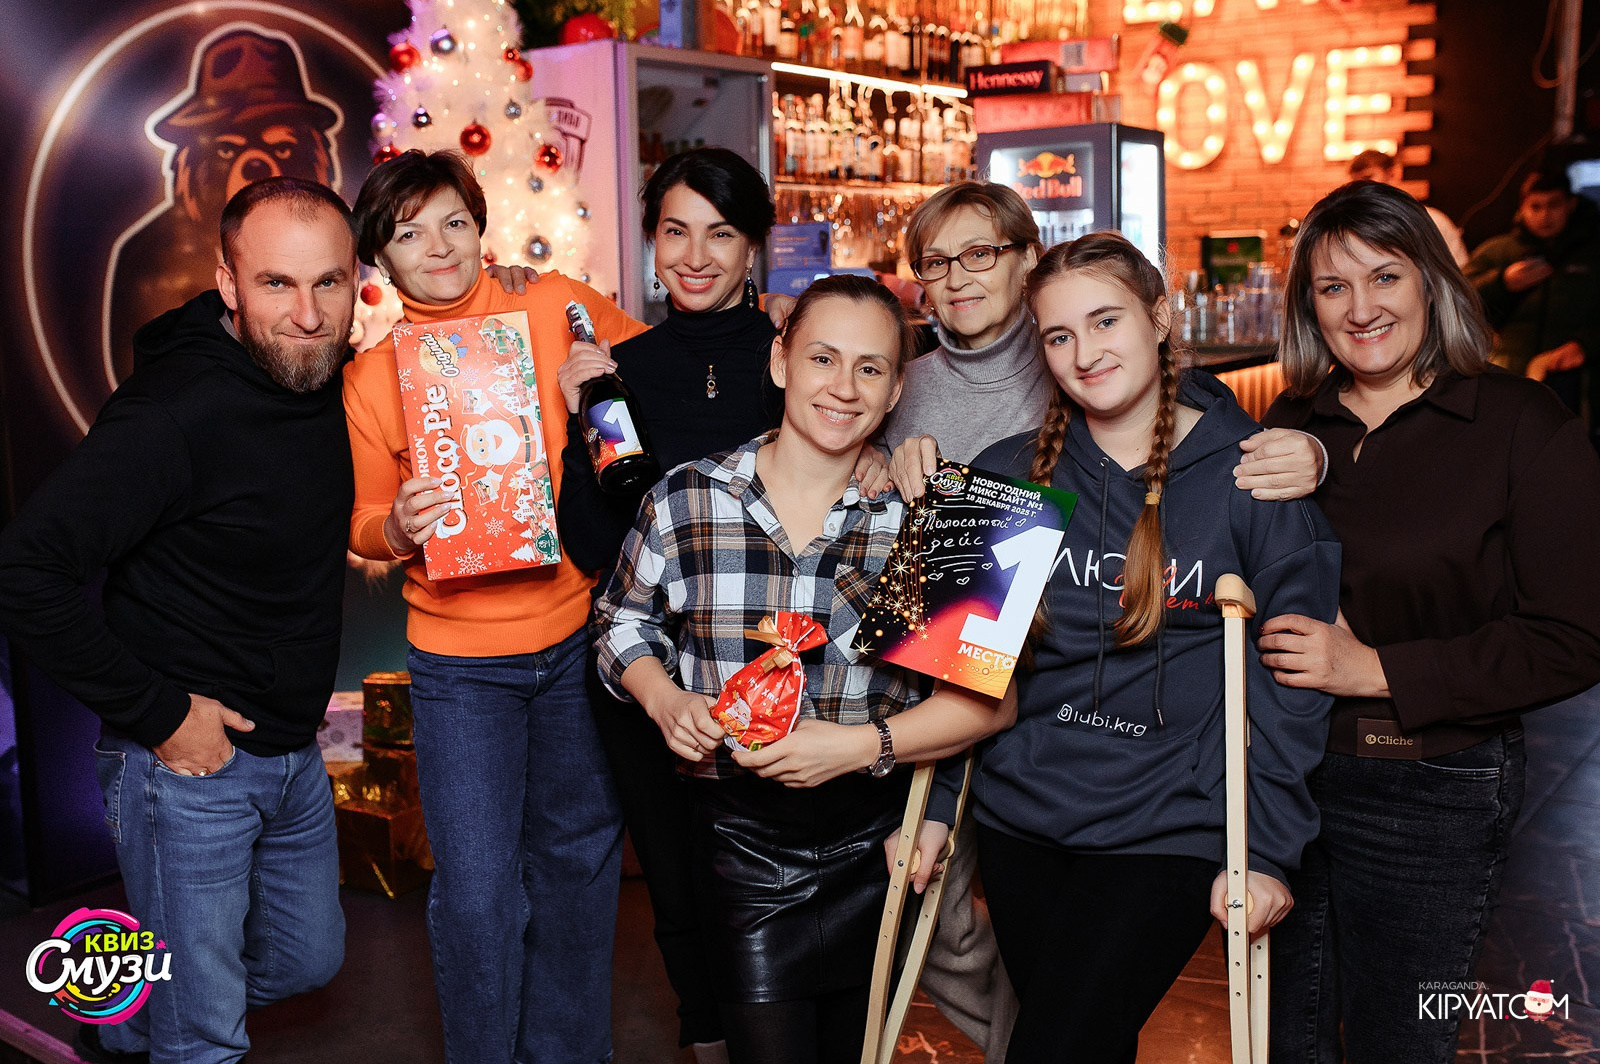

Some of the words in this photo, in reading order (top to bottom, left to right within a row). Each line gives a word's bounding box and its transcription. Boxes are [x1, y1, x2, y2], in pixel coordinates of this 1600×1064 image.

[969, 69, 1045, 91] Hennessy
[1047, 175, 1083, 199] Bull
[418, 332, 460, 377] Original
[603, 400, 643, 455] 1
[930, 472, 966, 490] Смузи
[972, 476, 1042, 501] НОВОГОДНИЙ
[965, 494, 976, 502] 18
[975, 497, 1011, 511] ДЕКАБРЯ
[1011, 506, 1030, 516] 2025
[968, 484, 998, 499] МИКС
[998, 493, 1027, 506] ЛАЙТ
[1027, 501, 1043, 511] №1
[923, 509, 1012, 531] Полосатый
[1047, 547, 1203, 598] ЛЮИ
[958, 525, 1065, 657] 1
[957, 643, 1016, 670] МЕСТО
[1377, 735, 1414, 746] Cliche
